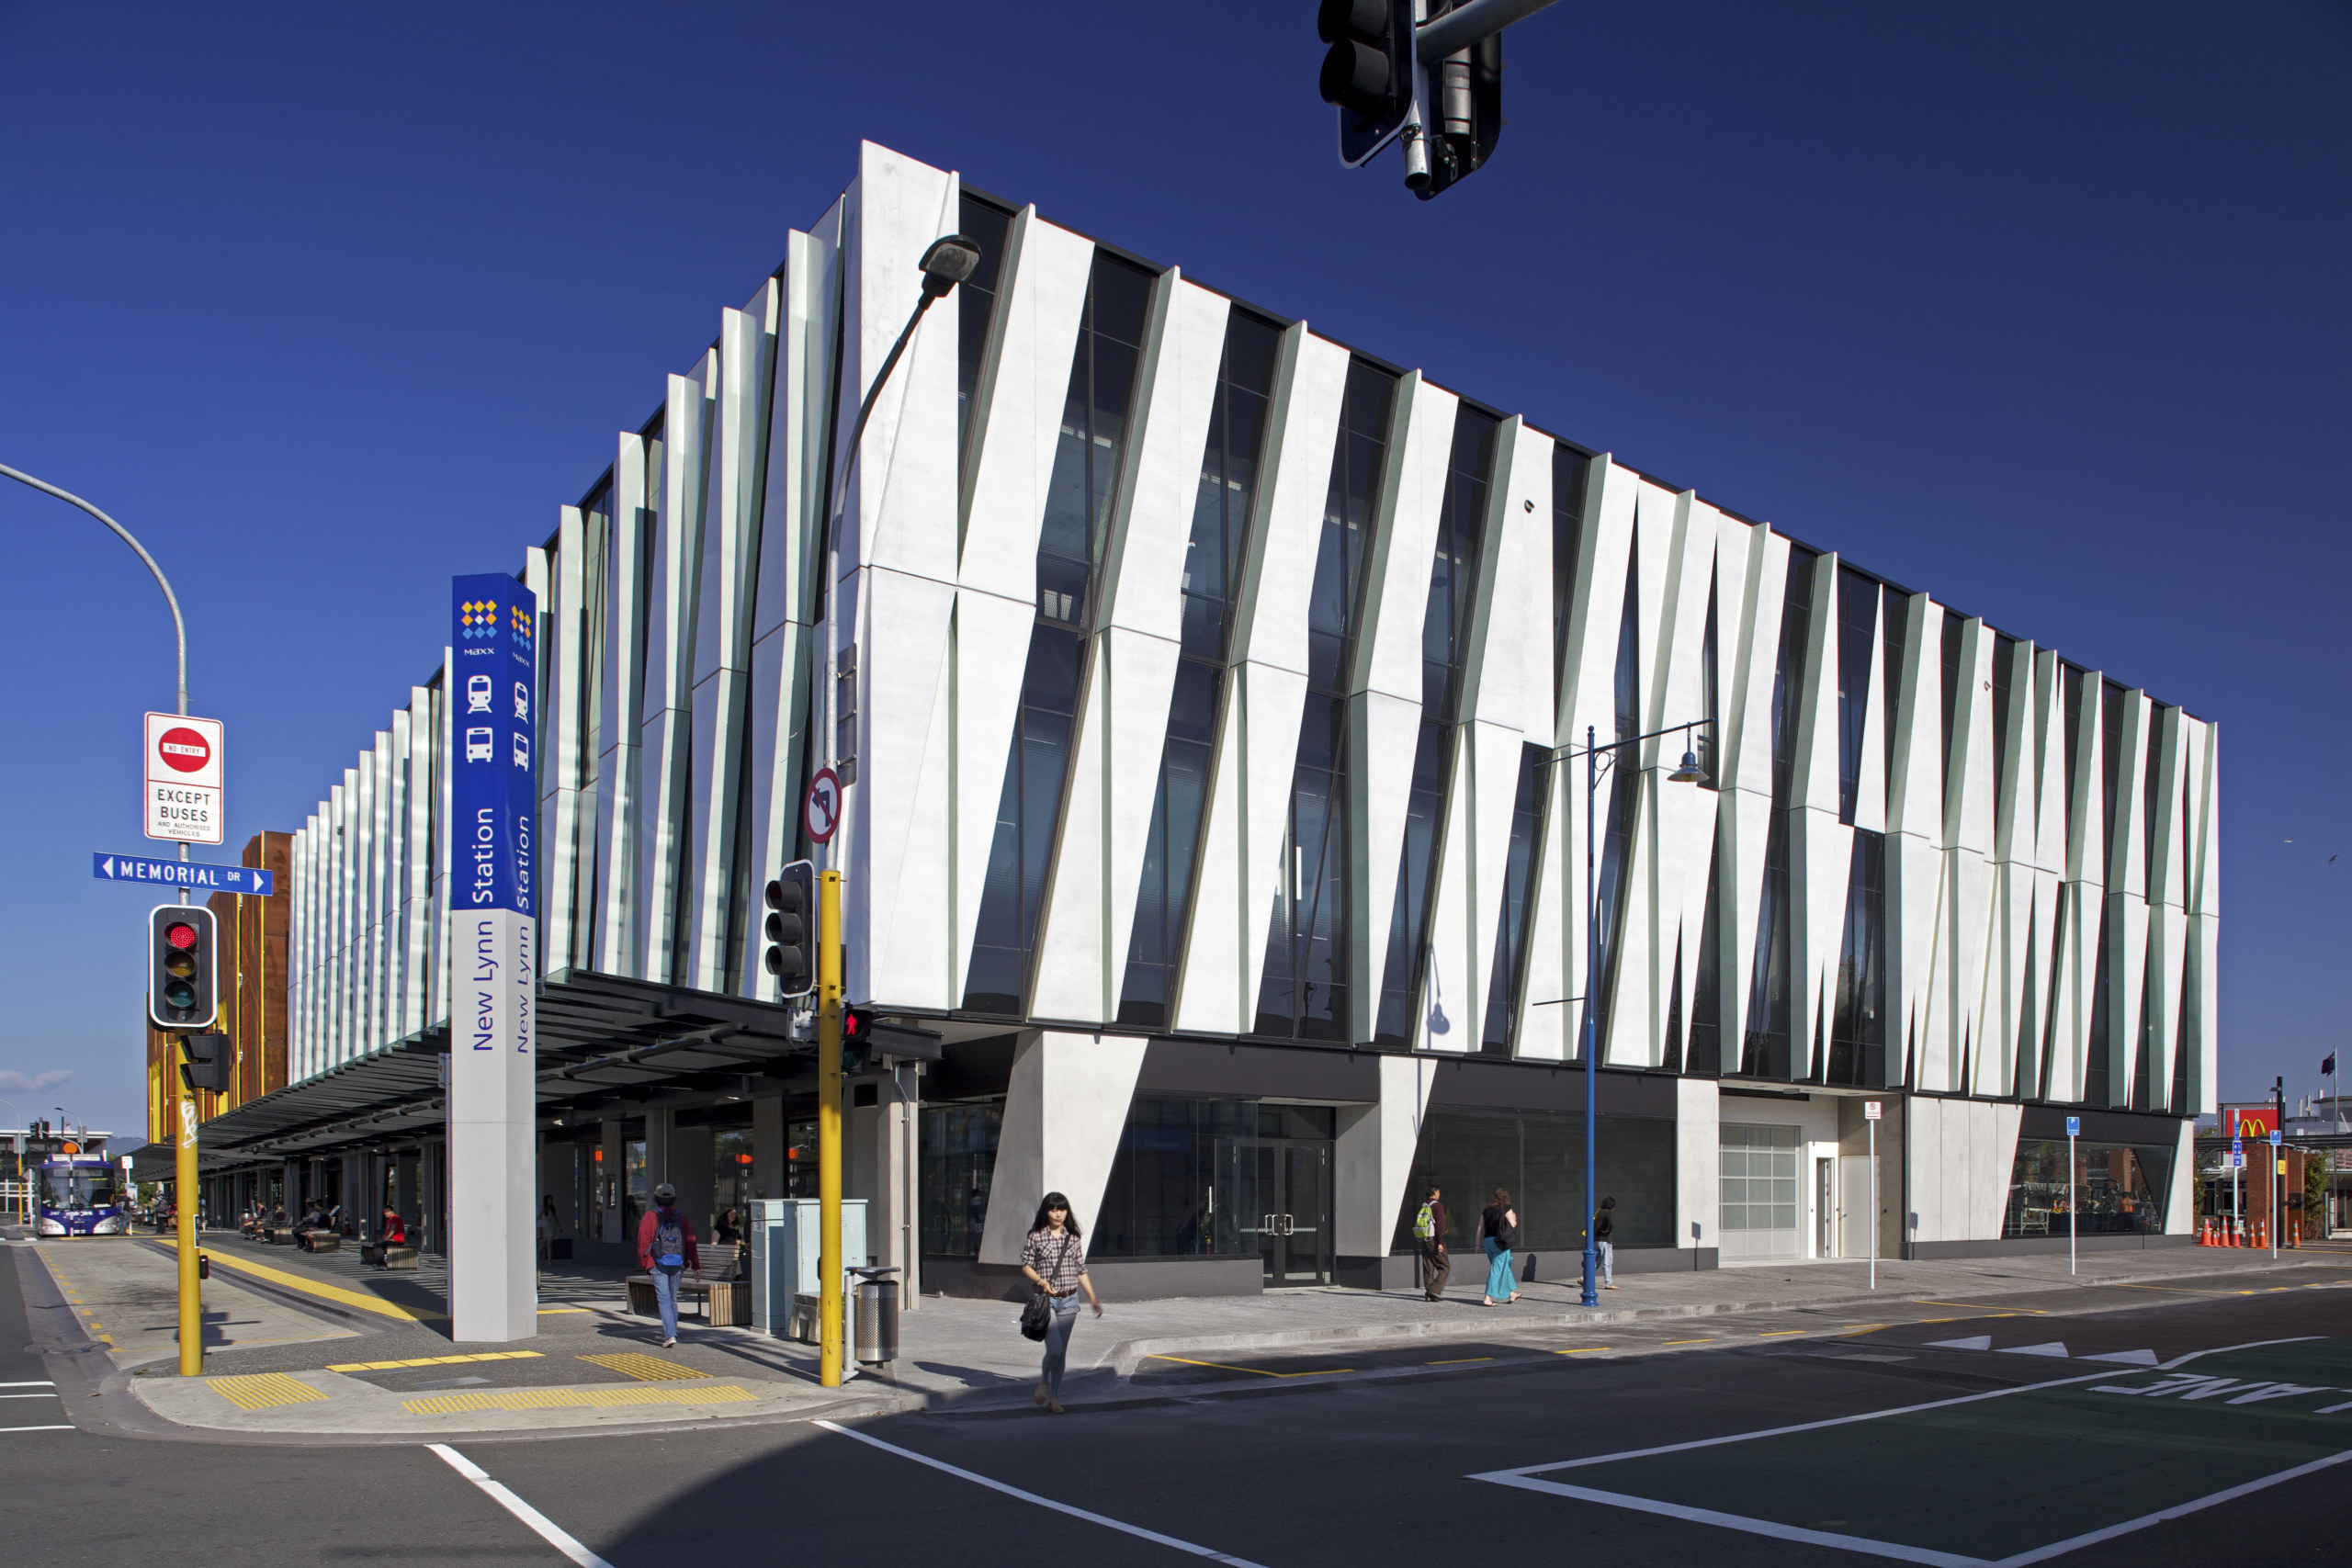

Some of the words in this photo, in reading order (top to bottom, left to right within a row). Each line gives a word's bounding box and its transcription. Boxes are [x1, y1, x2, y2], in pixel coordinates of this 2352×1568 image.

[181, 746, 200, 754] ENTRY
[158, 789, 210, 806] EXCEPT
[160, 807, 209, 822] BUSES
[168, 829, 200, 837] VEHICLES
[174, 822, 210, 831] AUTHORISED
[120, 861, 220, 886] MEMORIAL
[227, 871, 241, 882] DR
[472, 808, 493, 903] Station
[516, 816, 529, 909] Station
[473, 920, 499, 981] Lynn
[517, 926, 532, 986] Lynn
[473, 992, 493, 1051] New
[517, 995, 529, 1054] New
